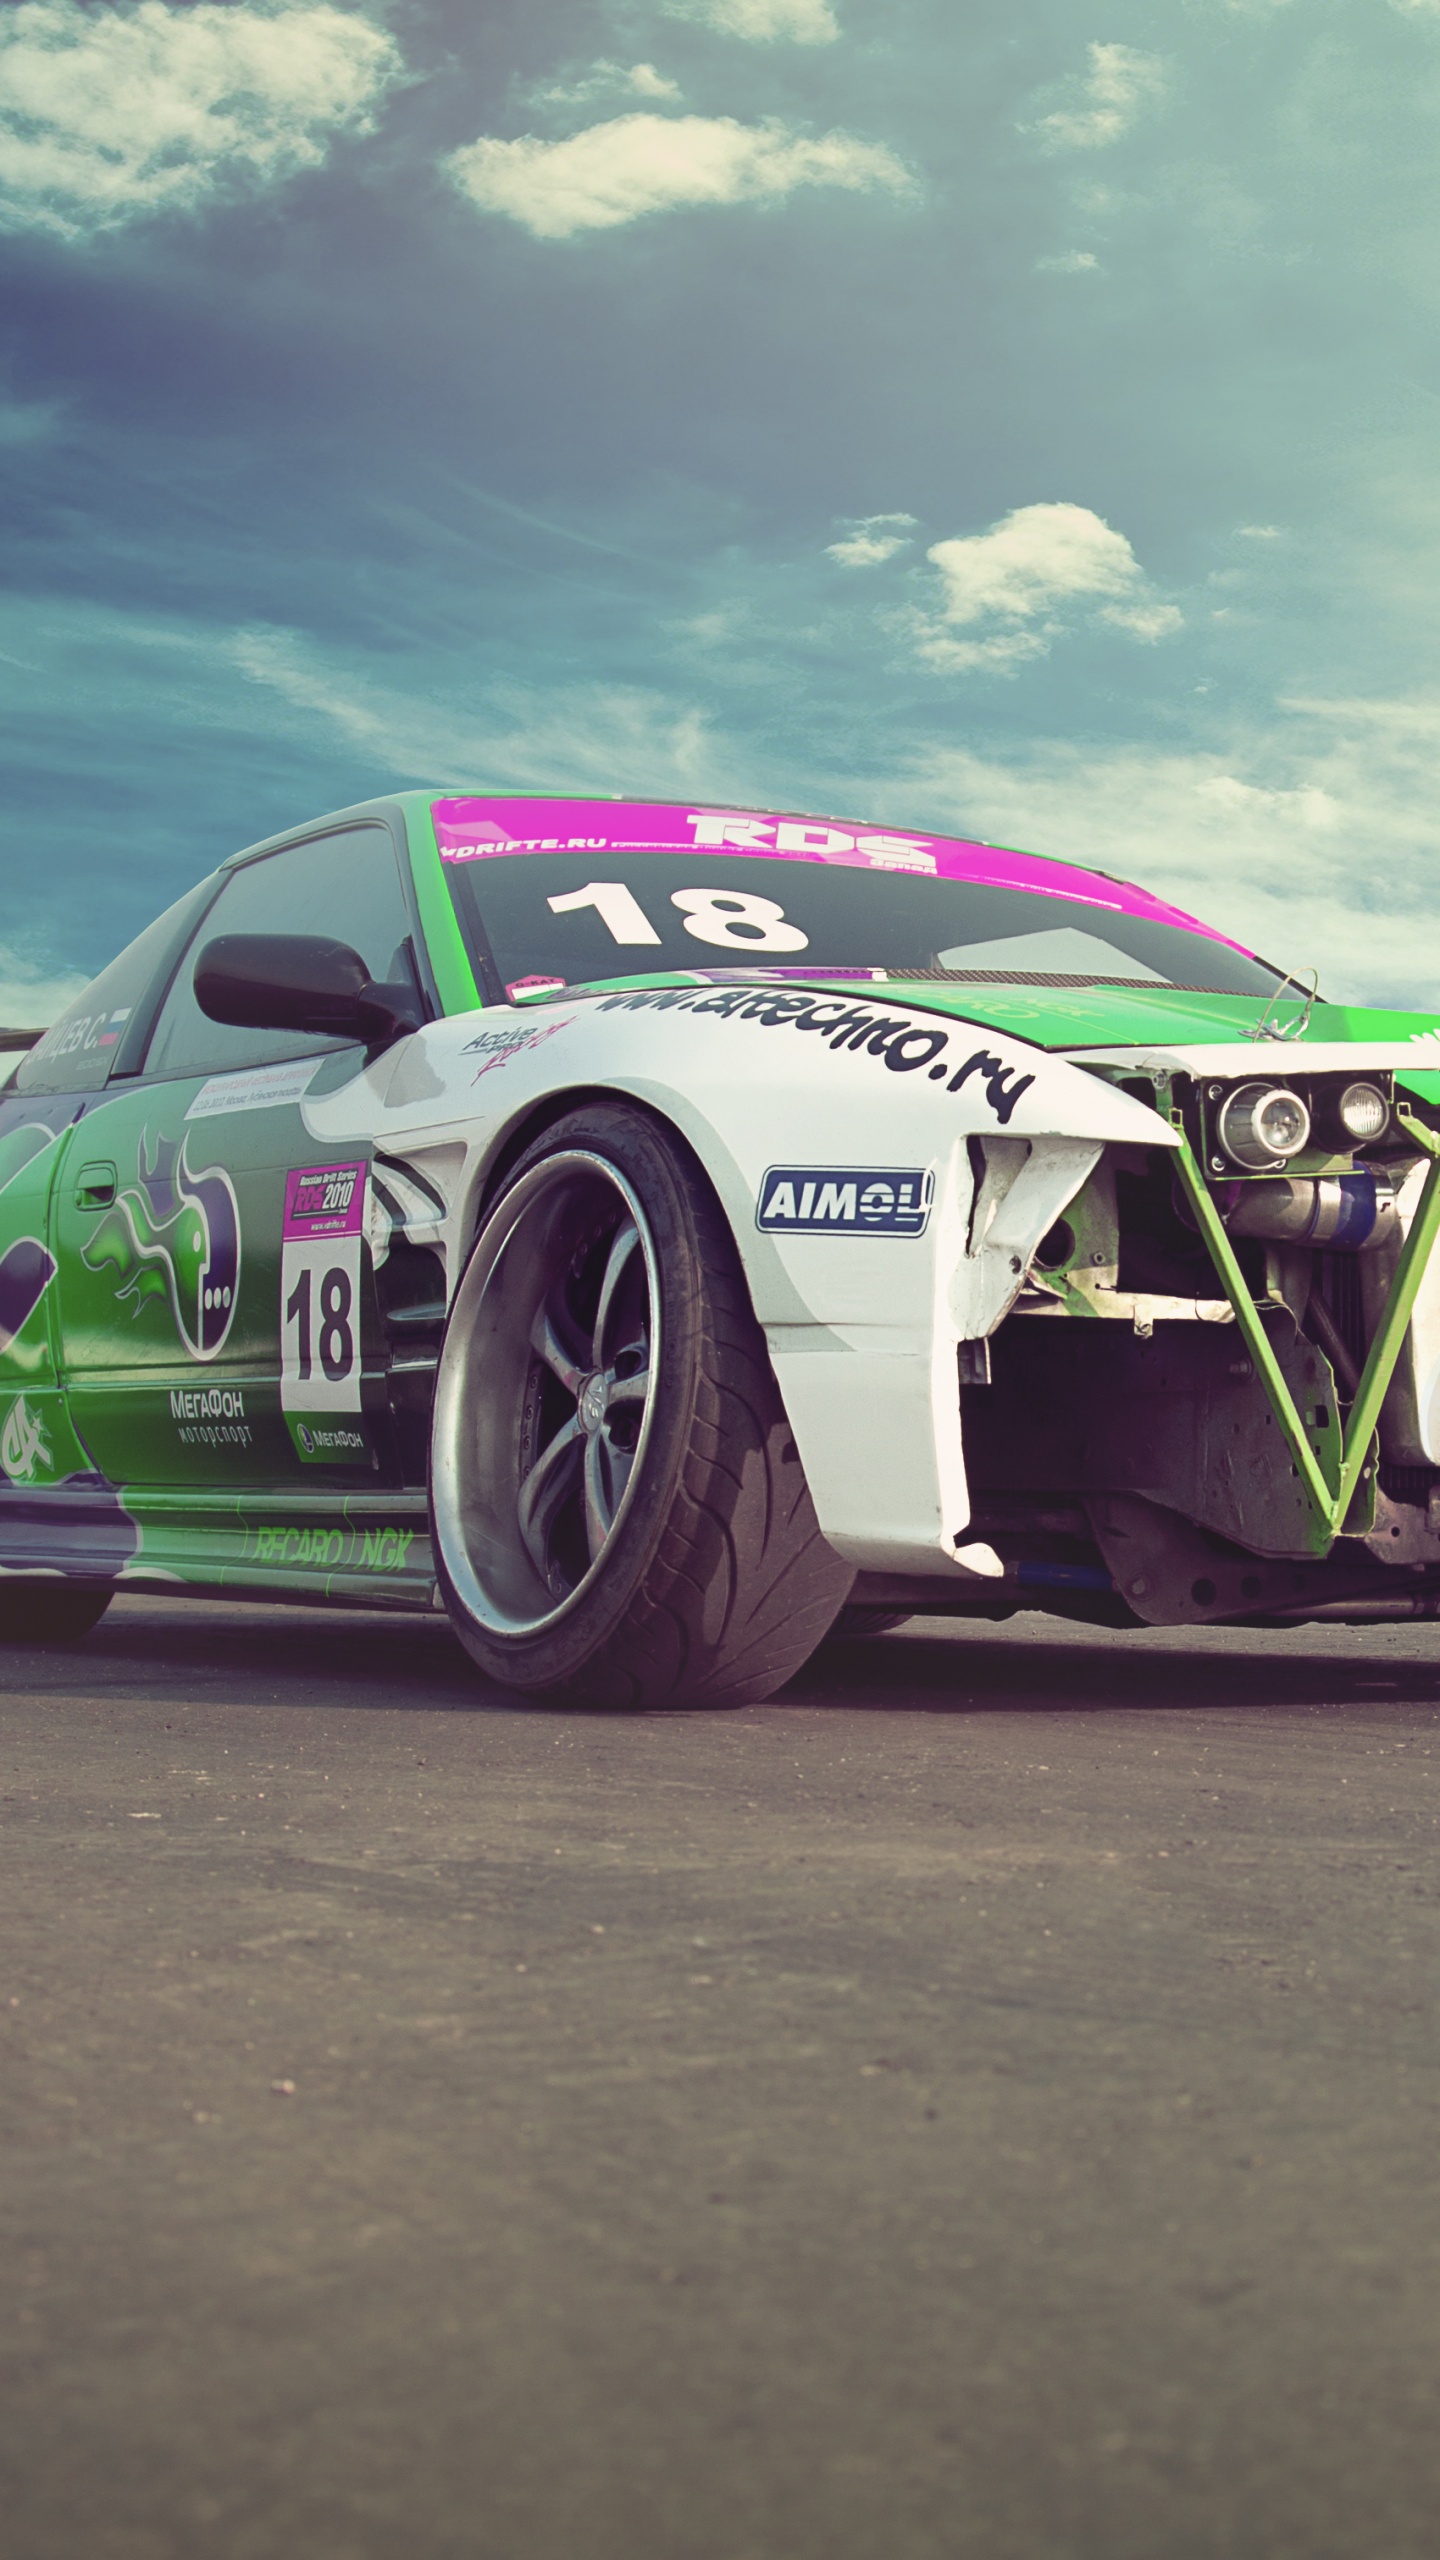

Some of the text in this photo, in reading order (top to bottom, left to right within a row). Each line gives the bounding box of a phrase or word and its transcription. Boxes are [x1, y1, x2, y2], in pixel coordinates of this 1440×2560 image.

[687, 815, 936, 867] RDS
[546, 882, 809, 952] 18
[461, 1025, 539, 1051] Active
[294, 1181, 355, 1213] RDS 2010
[300, 1170, 358, 1187] Russian Drift Series
[762, 1181, 925, 1222] AIMOL
[287, 1267, 354, 1382] 18
[177, 1425, 253, 1449] моторспорт
[249, 1526, 415, 1572] RECARO NGK
